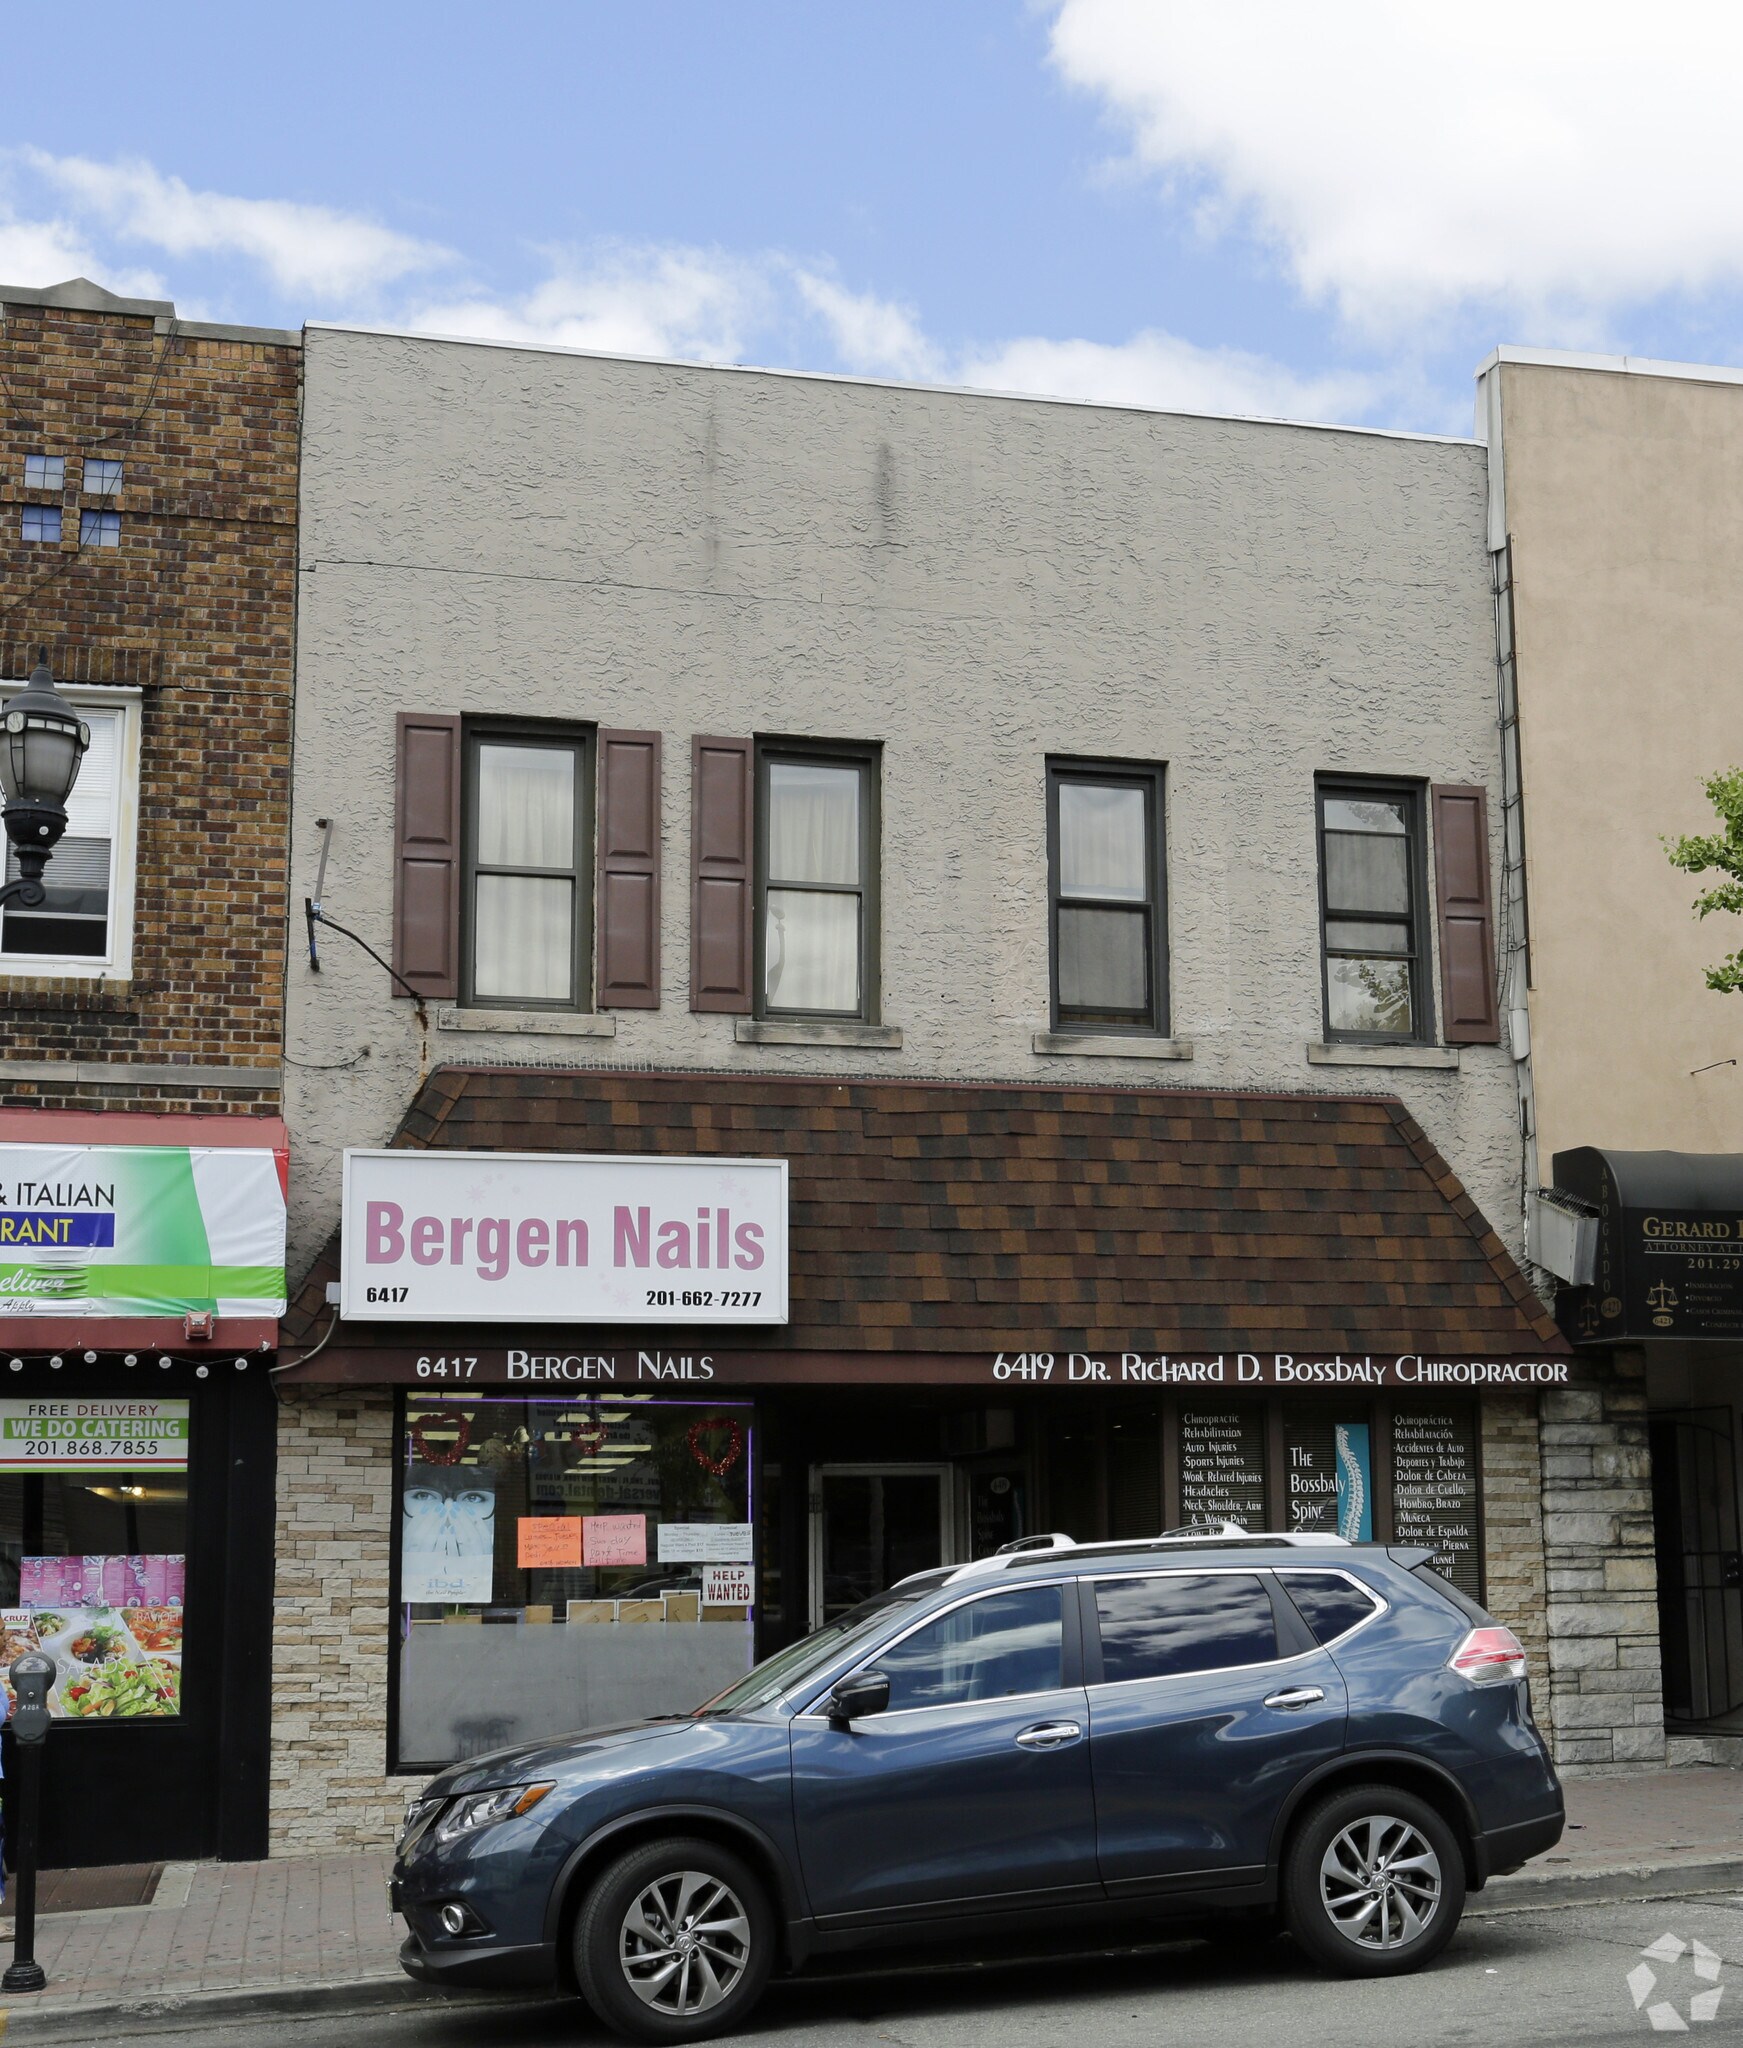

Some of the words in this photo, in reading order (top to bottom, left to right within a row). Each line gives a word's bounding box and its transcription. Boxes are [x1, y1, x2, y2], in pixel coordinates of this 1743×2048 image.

[17, 1183, 114, 1206] ITALIAN
[1, 1218, 73, 1243] RANT
[1643, 1217, 1730, 1238] GERARD
[366, 1200, 589, 1281] Bergen
[614, 1206, 764, 1270] Nails
[1646, 1242, 1713, 1252] ATTORNEY
[366, 1287, 409, 1303] 6417
[646, 1290, 762, 1306] 201-662-7277
[416, 1356, 478, 1378] 6417
[507, 1350, 614, 1380] BERGEN
[638, 1351, 714, 1380] NAILS
[993, 1352, 1054, 1380] 6419
[1068, 1354, 1111, 1380] Dr.
[1238, 1354, 1263, 1381] D.
[28, 1405, 68, 1416] FREE
[77, 1405, 159, 1416] DELIVERY
[11, 1420, 42, 1437] WE
[48, 1420, 76, 1437] DO
[81, 1420, 180, 1437] CATERING
[25, 1440, 158, 1455] 201.868.7855
[1436, 1442, 1444, 1452] de
[1425, 1470, 1433, 1480] de
[1426, 1484, 1434, 1494] de
[1192, 1514, 1198, 1524] &
[1426, 1525, 1435, 1536] de
[713, 1570, 745, 1580] HELP
[708, 1584, 750, 1600] WANTED
[56, 1657, 128, 1674] SALADS
